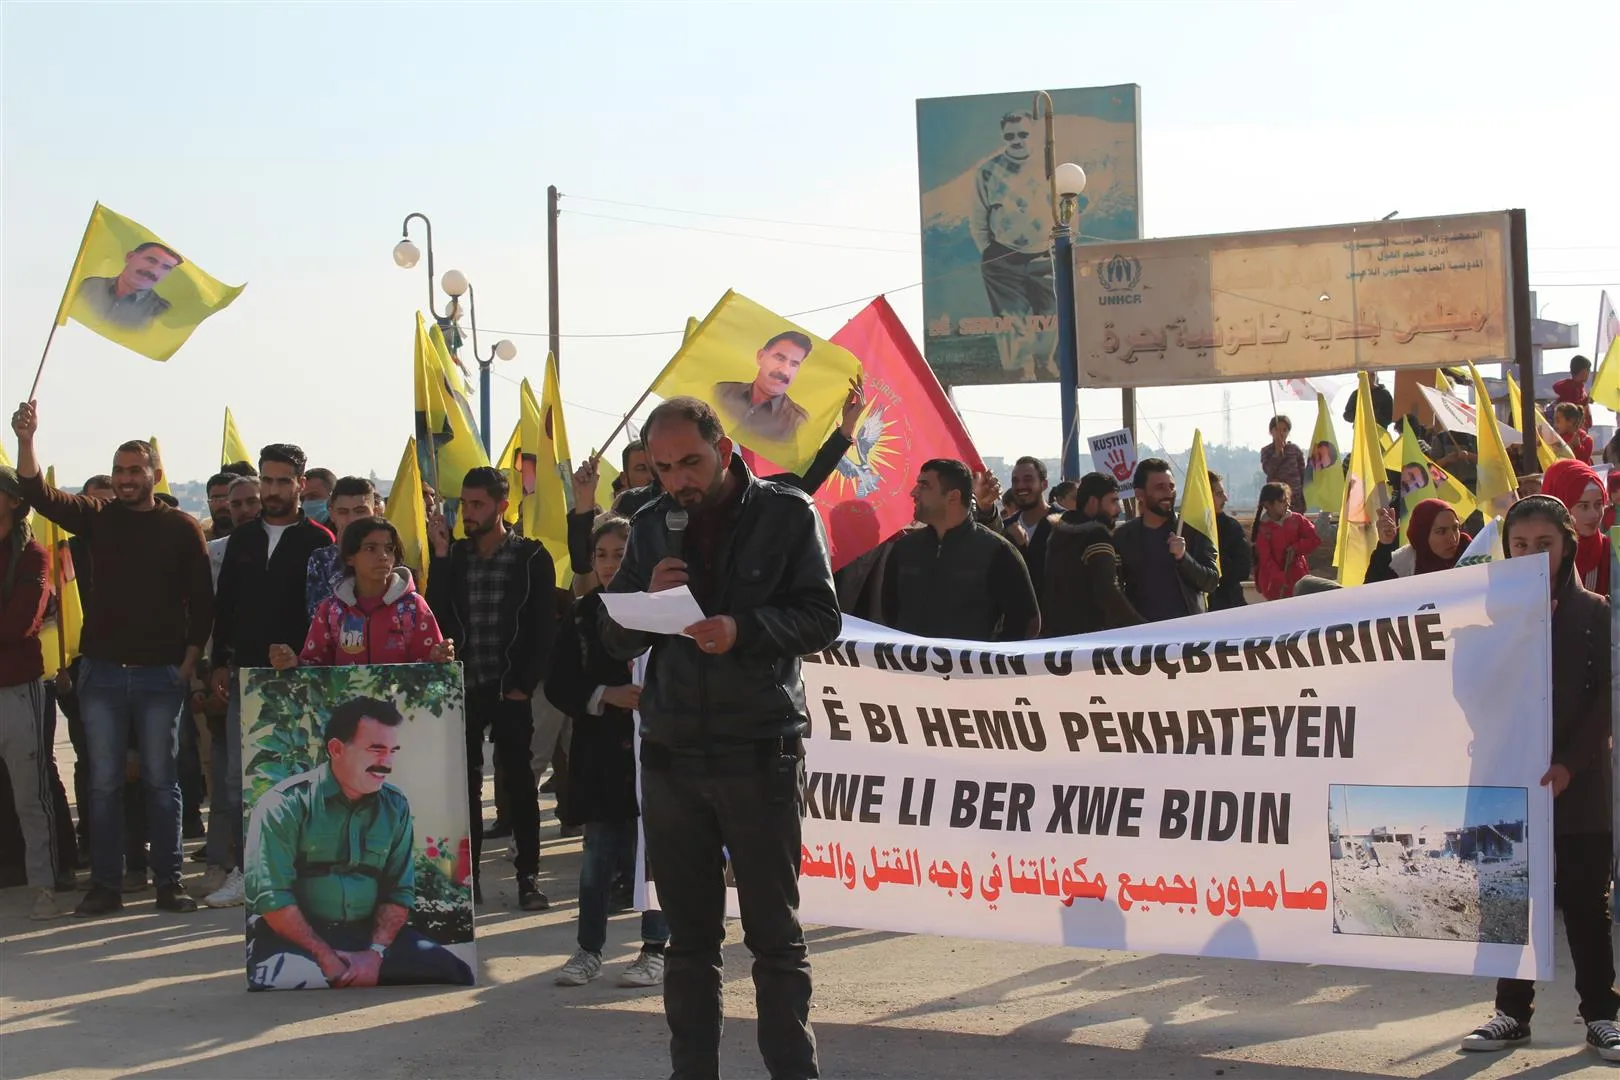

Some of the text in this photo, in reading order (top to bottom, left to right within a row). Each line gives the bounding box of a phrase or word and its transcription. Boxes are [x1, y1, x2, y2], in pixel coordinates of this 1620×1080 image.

[1098, 294, 1142, 306] UNHCR
[859, 702, 908, 744] BI
[916, 697, 1047, 752] HEMÛ
[1059, 688, 1356, 759] PÊKHATEYÊN
[899, 777, 936, 826] LI
[950, 780, 1035, 832] BER
[1045, 784, 1145, 837] XWE
[1159, 789, 1291, 845] BIDIN
[863, 846, 922, 891] القتل
[928, 858, 973, 900] وجه
[980, 851, 1003, 910] في
[1007, 855, 1107, 907] مكوناتنا
[1206, 868, 1328, 917] صامدون
[1118, 872, 1198, 915] بجميع
